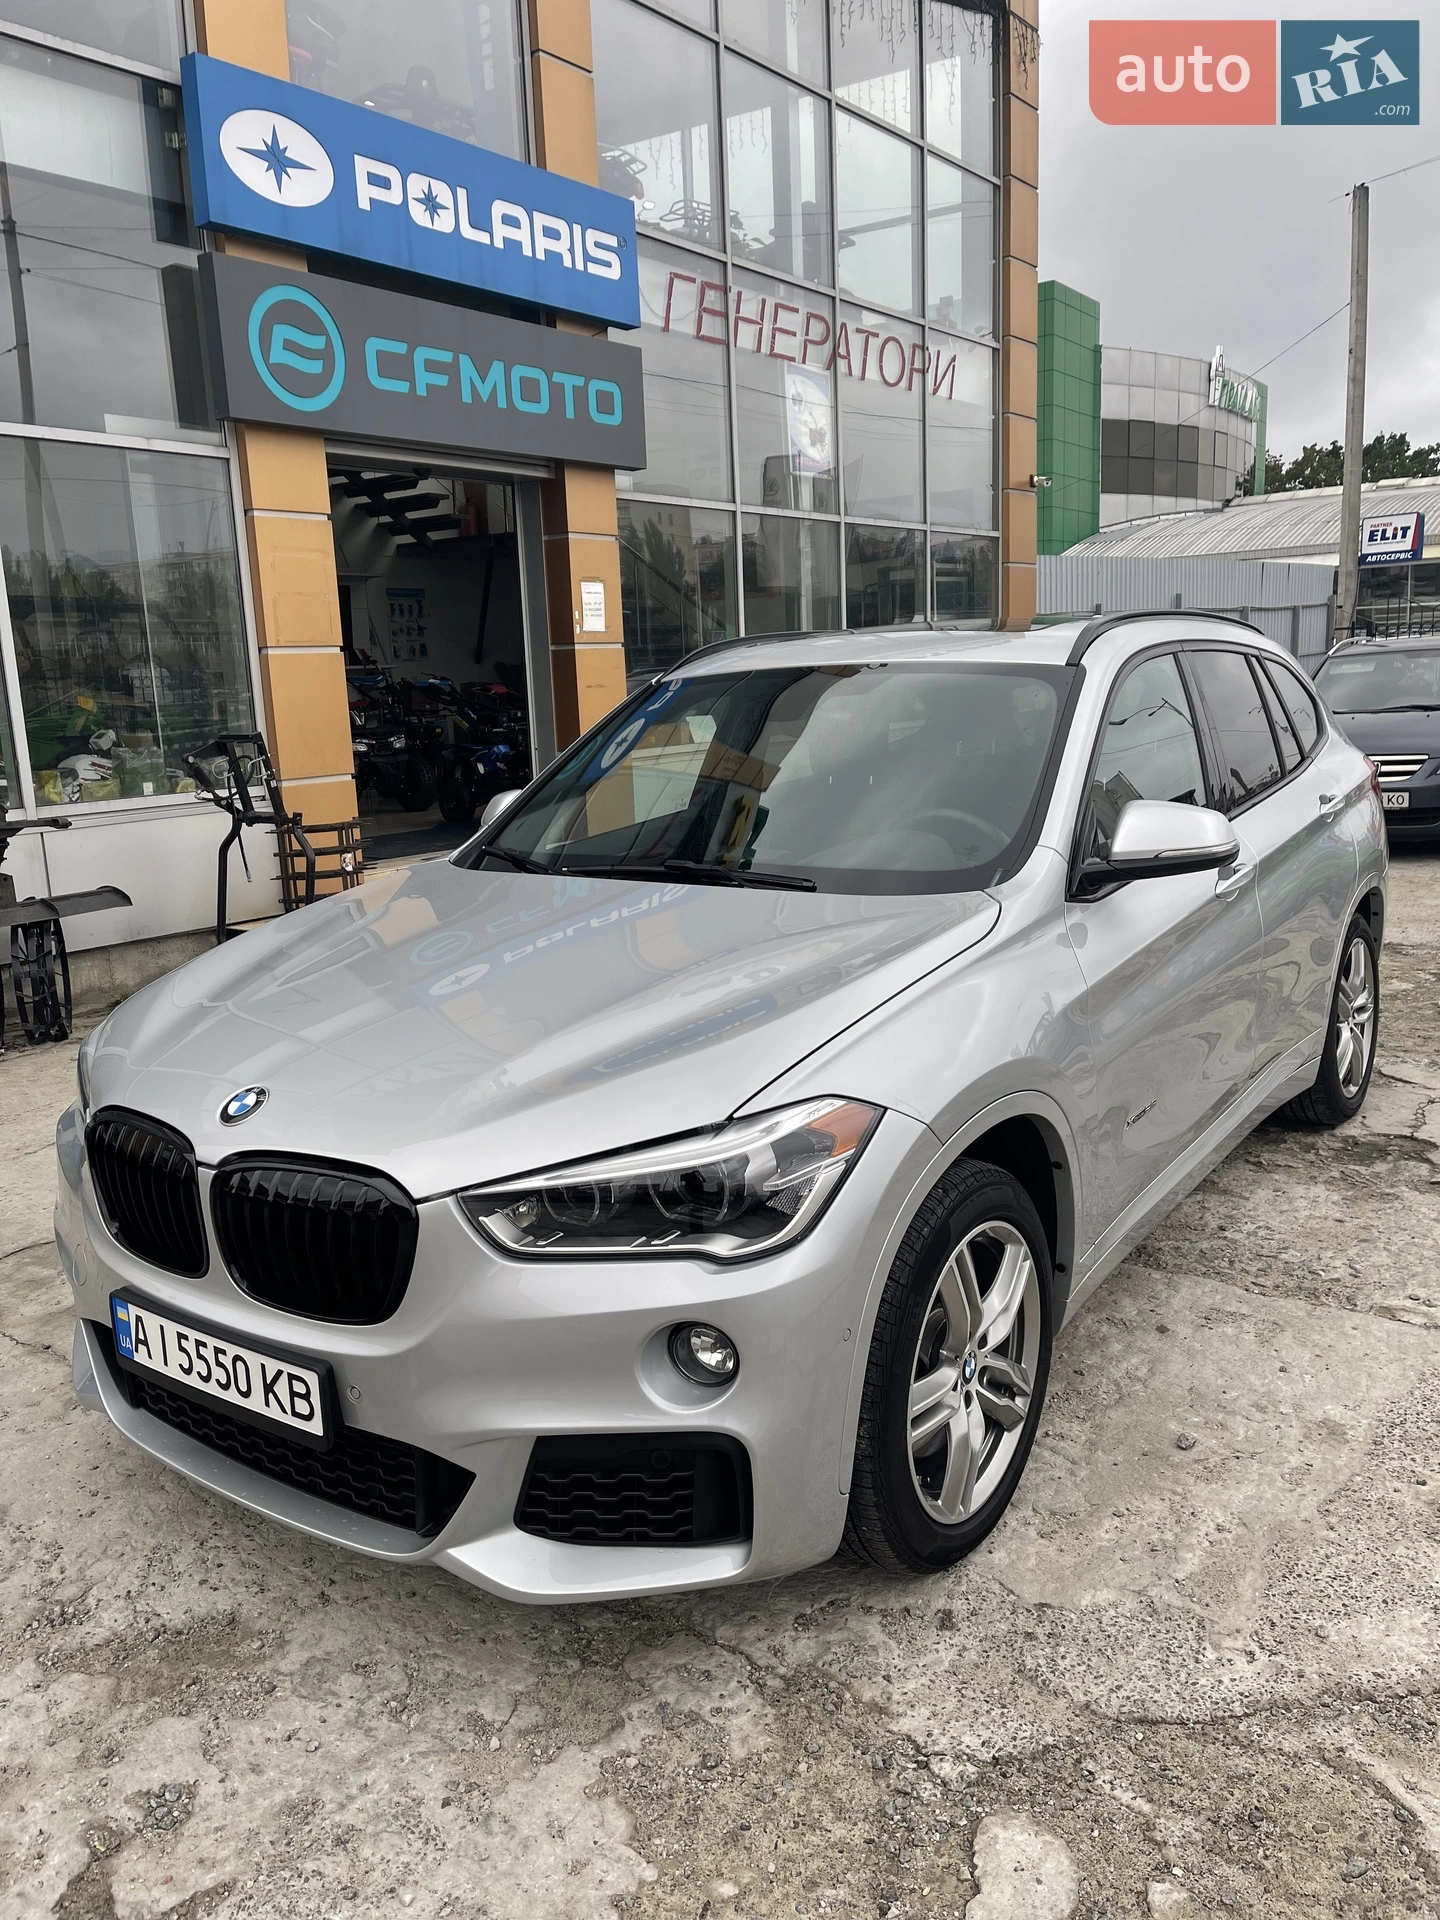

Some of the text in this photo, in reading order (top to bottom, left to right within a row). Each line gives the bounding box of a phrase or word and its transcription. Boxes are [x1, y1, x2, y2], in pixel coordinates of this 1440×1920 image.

[352, 152, 622, 281] POLARIS
[364, 335, 624, 427] CFMOTO
[661, 270, 958, 401] ГЕНЕРАТОРИ
[1366, 552, 1413, 562] АВТОСЕРВІС
[1387, 794, 1405, 806] KO
[119, 1333, 132, 1350] UA
[134, 1313, 315, 1423] AI 5550 KB
